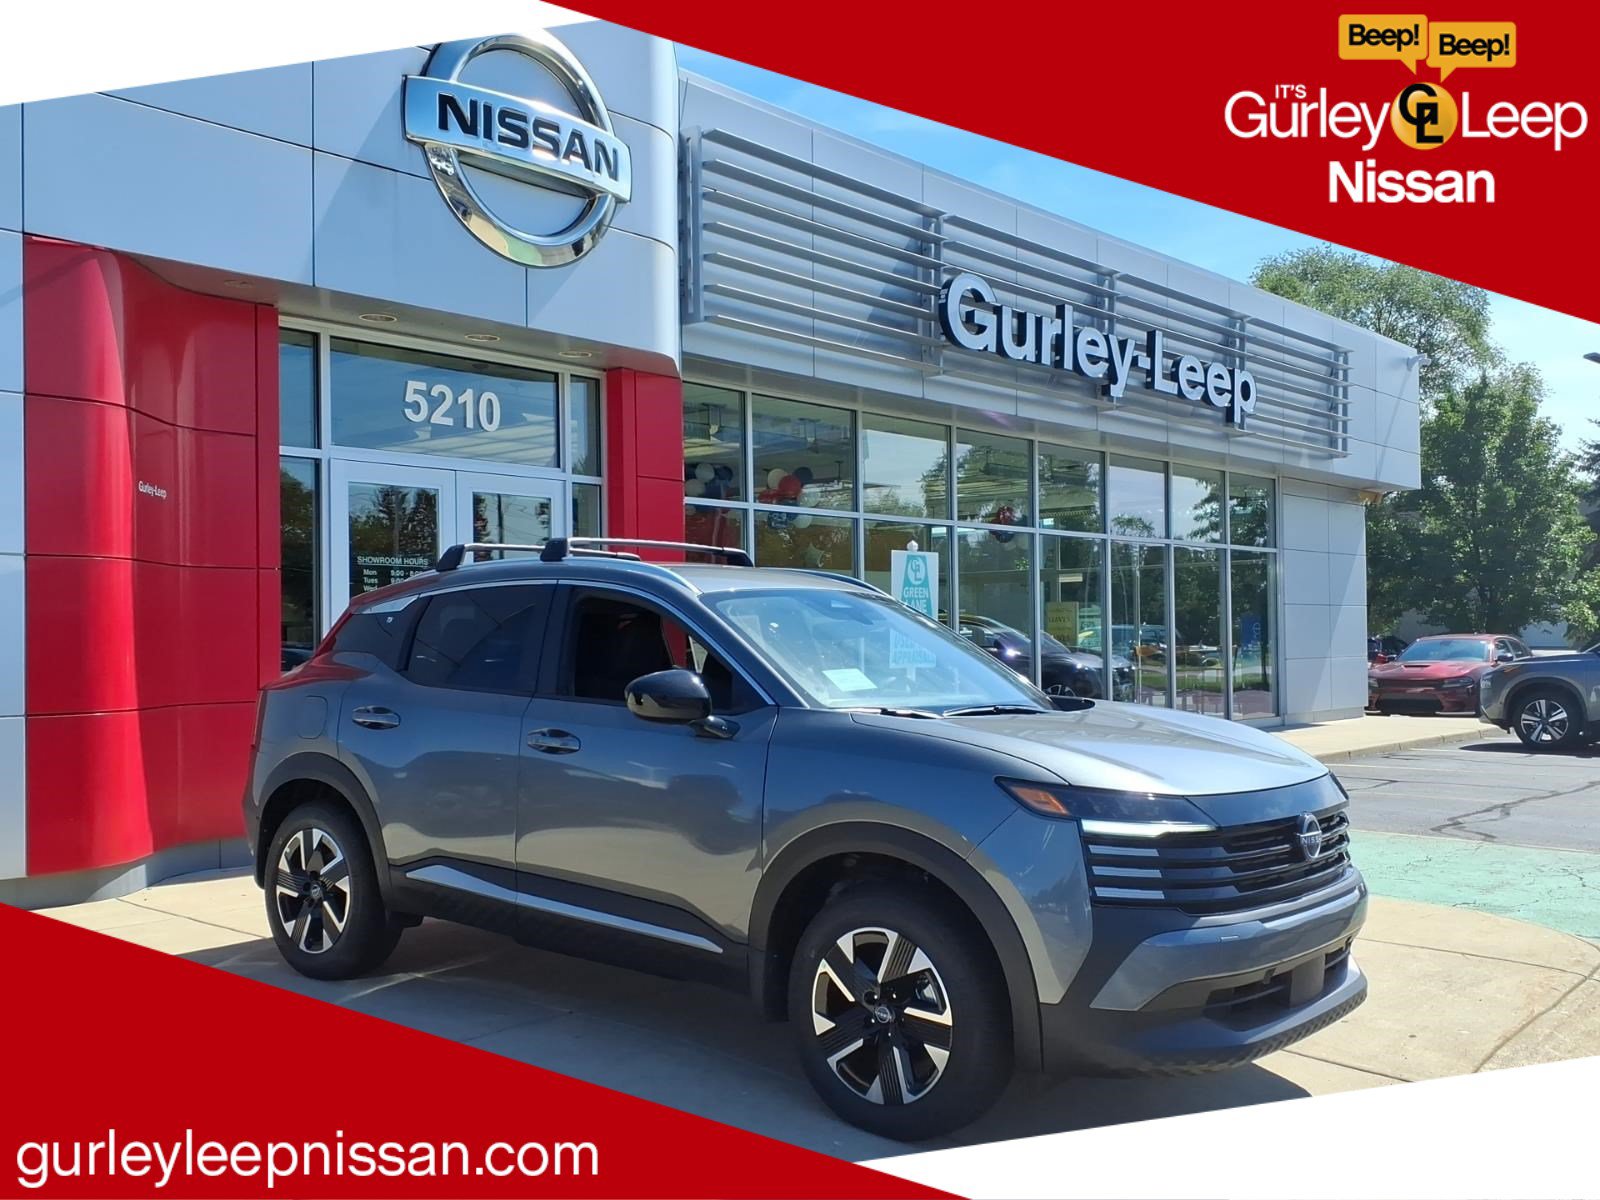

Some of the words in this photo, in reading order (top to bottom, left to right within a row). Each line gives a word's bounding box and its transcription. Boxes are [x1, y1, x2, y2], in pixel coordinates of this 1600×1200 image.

[437, 92, 619, 182] NISSAN
[940, 272, 1257, 423] Gurley-Leep
[404, 380, 501, 432] 5210
[356, 556, 402, 564] SHOWROOM
[403, 558, 429, 566] HOURS
[903, 586, 929, 598] GREEN
